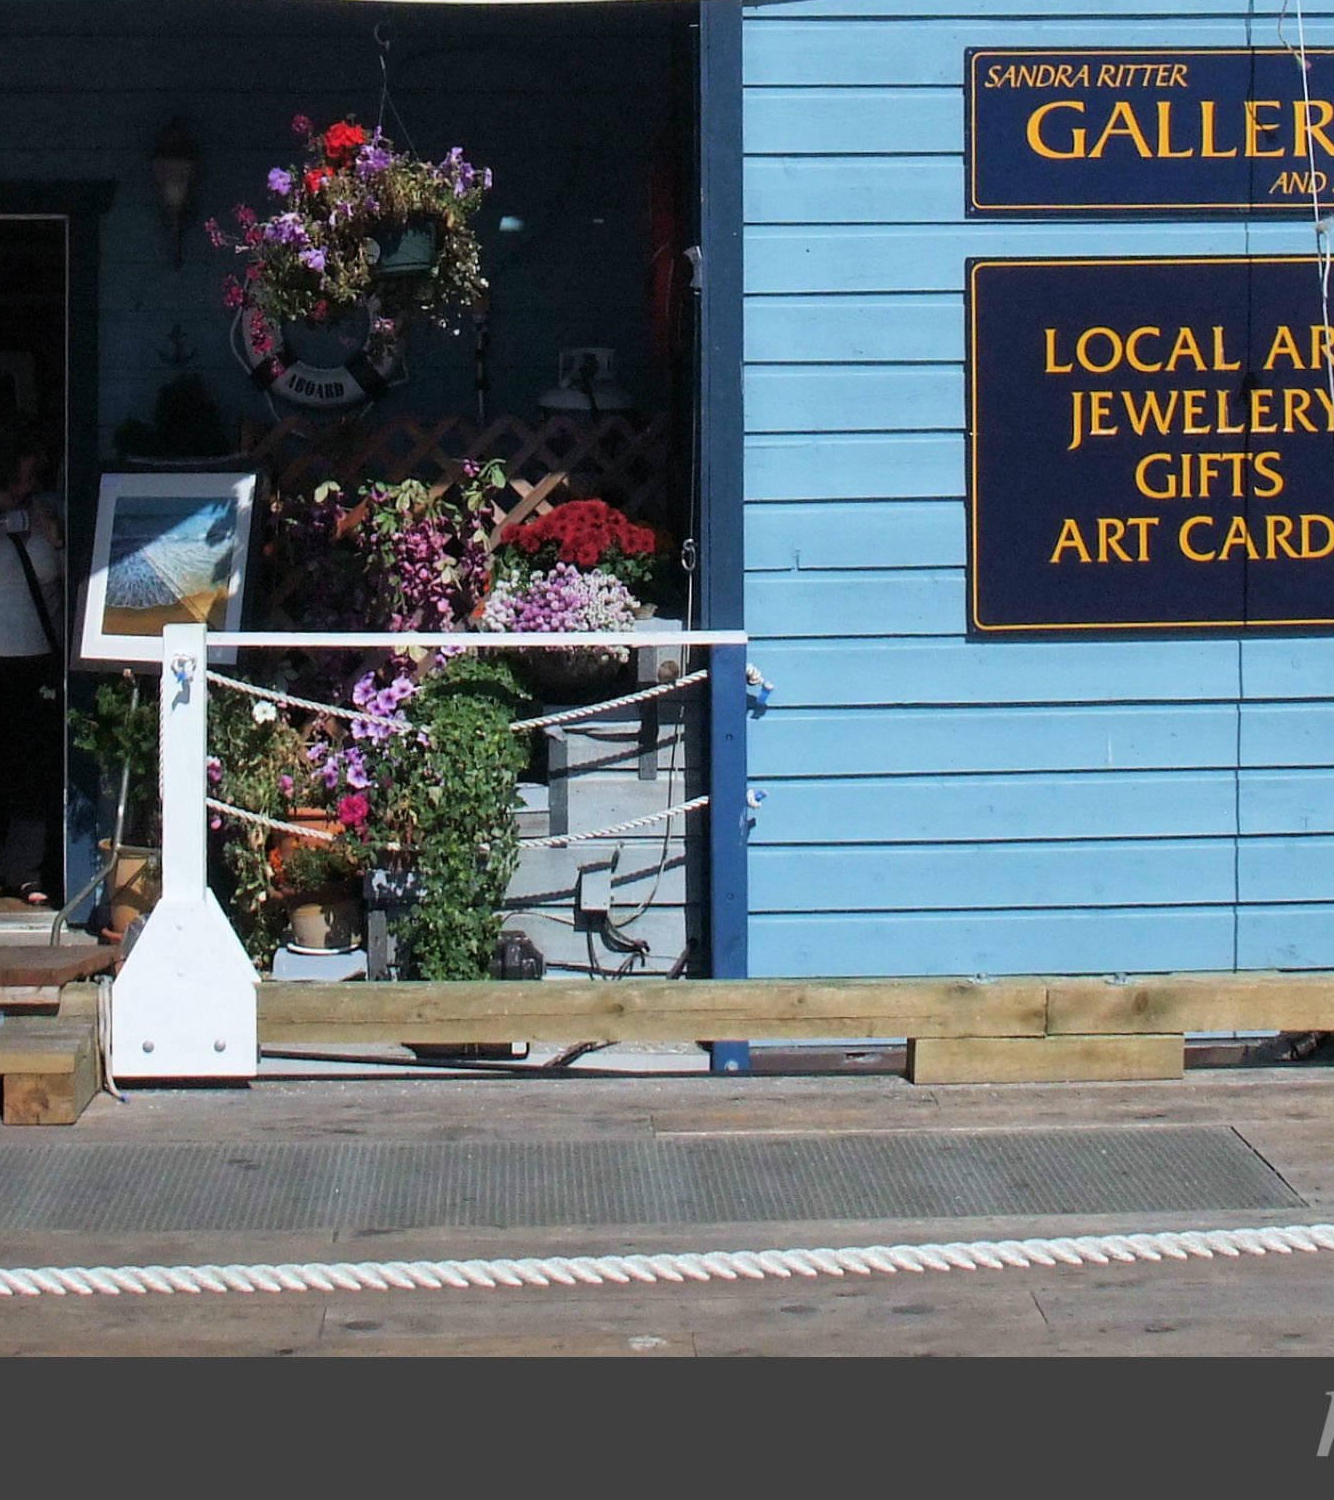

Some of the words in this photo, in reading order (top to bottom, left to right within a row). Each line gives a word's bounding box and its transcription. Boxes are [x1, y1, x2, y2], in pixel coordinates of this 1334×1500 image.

[984, 63, 1091, 88] SANDRA
[1096, 63, 1188, 87] RITTER
[1269, 171, 1326, 195] AND
[1043, 326, 1241, 374] LOCAL
[1135, 451, 1284, 499] GIFTS
[1049, 517, 1159, 564] ART
